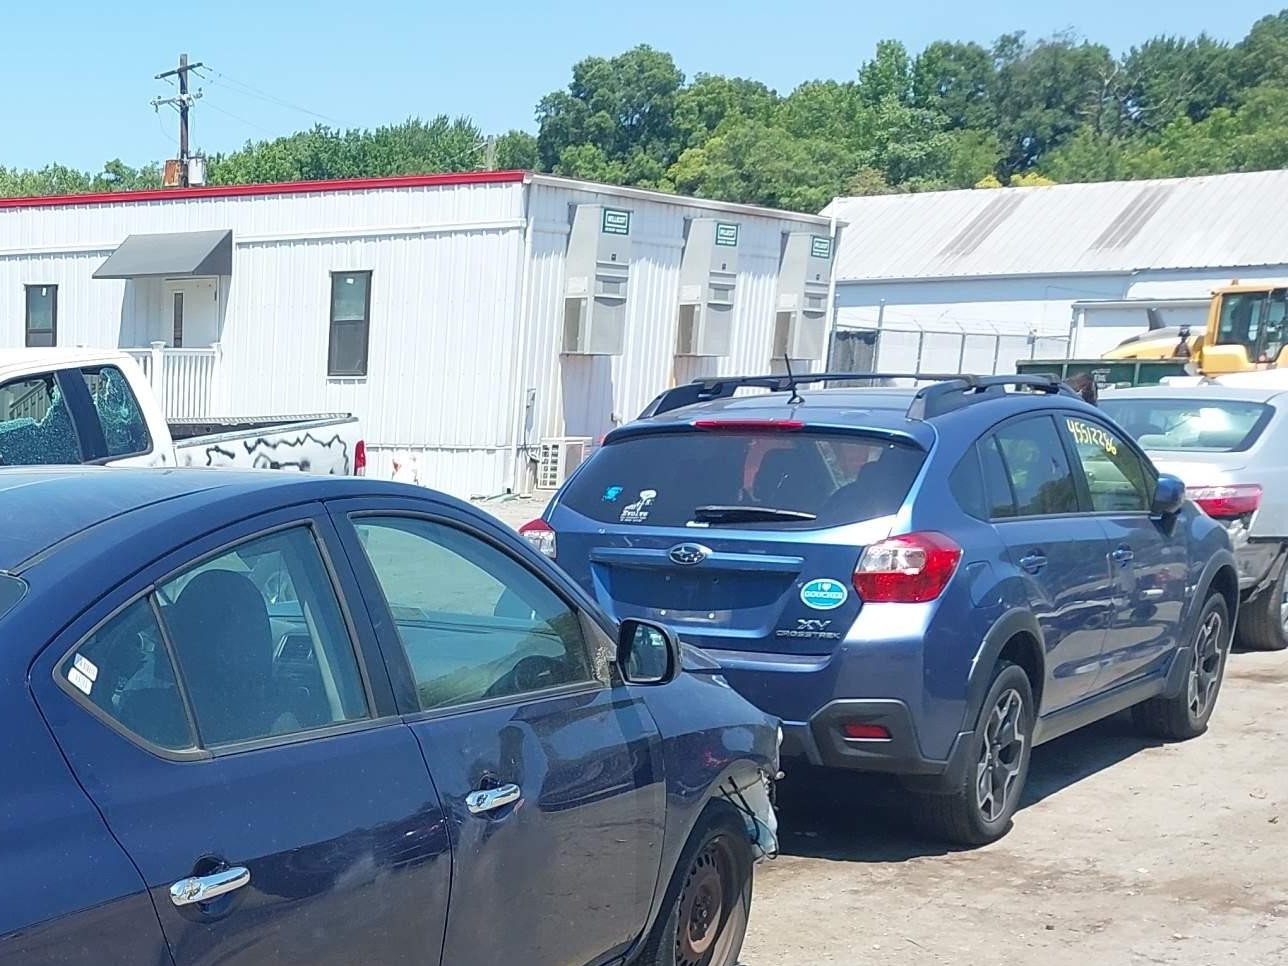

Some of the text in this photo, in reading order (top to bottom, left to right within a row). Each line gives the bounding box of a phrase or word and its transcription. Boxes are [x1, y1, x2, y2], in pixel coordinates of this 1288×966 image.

[1066, 418, 1117, 456] 45512286
[796, 619, 832, 631] XV
[775, 629, 841, 640] CROSSTREK
